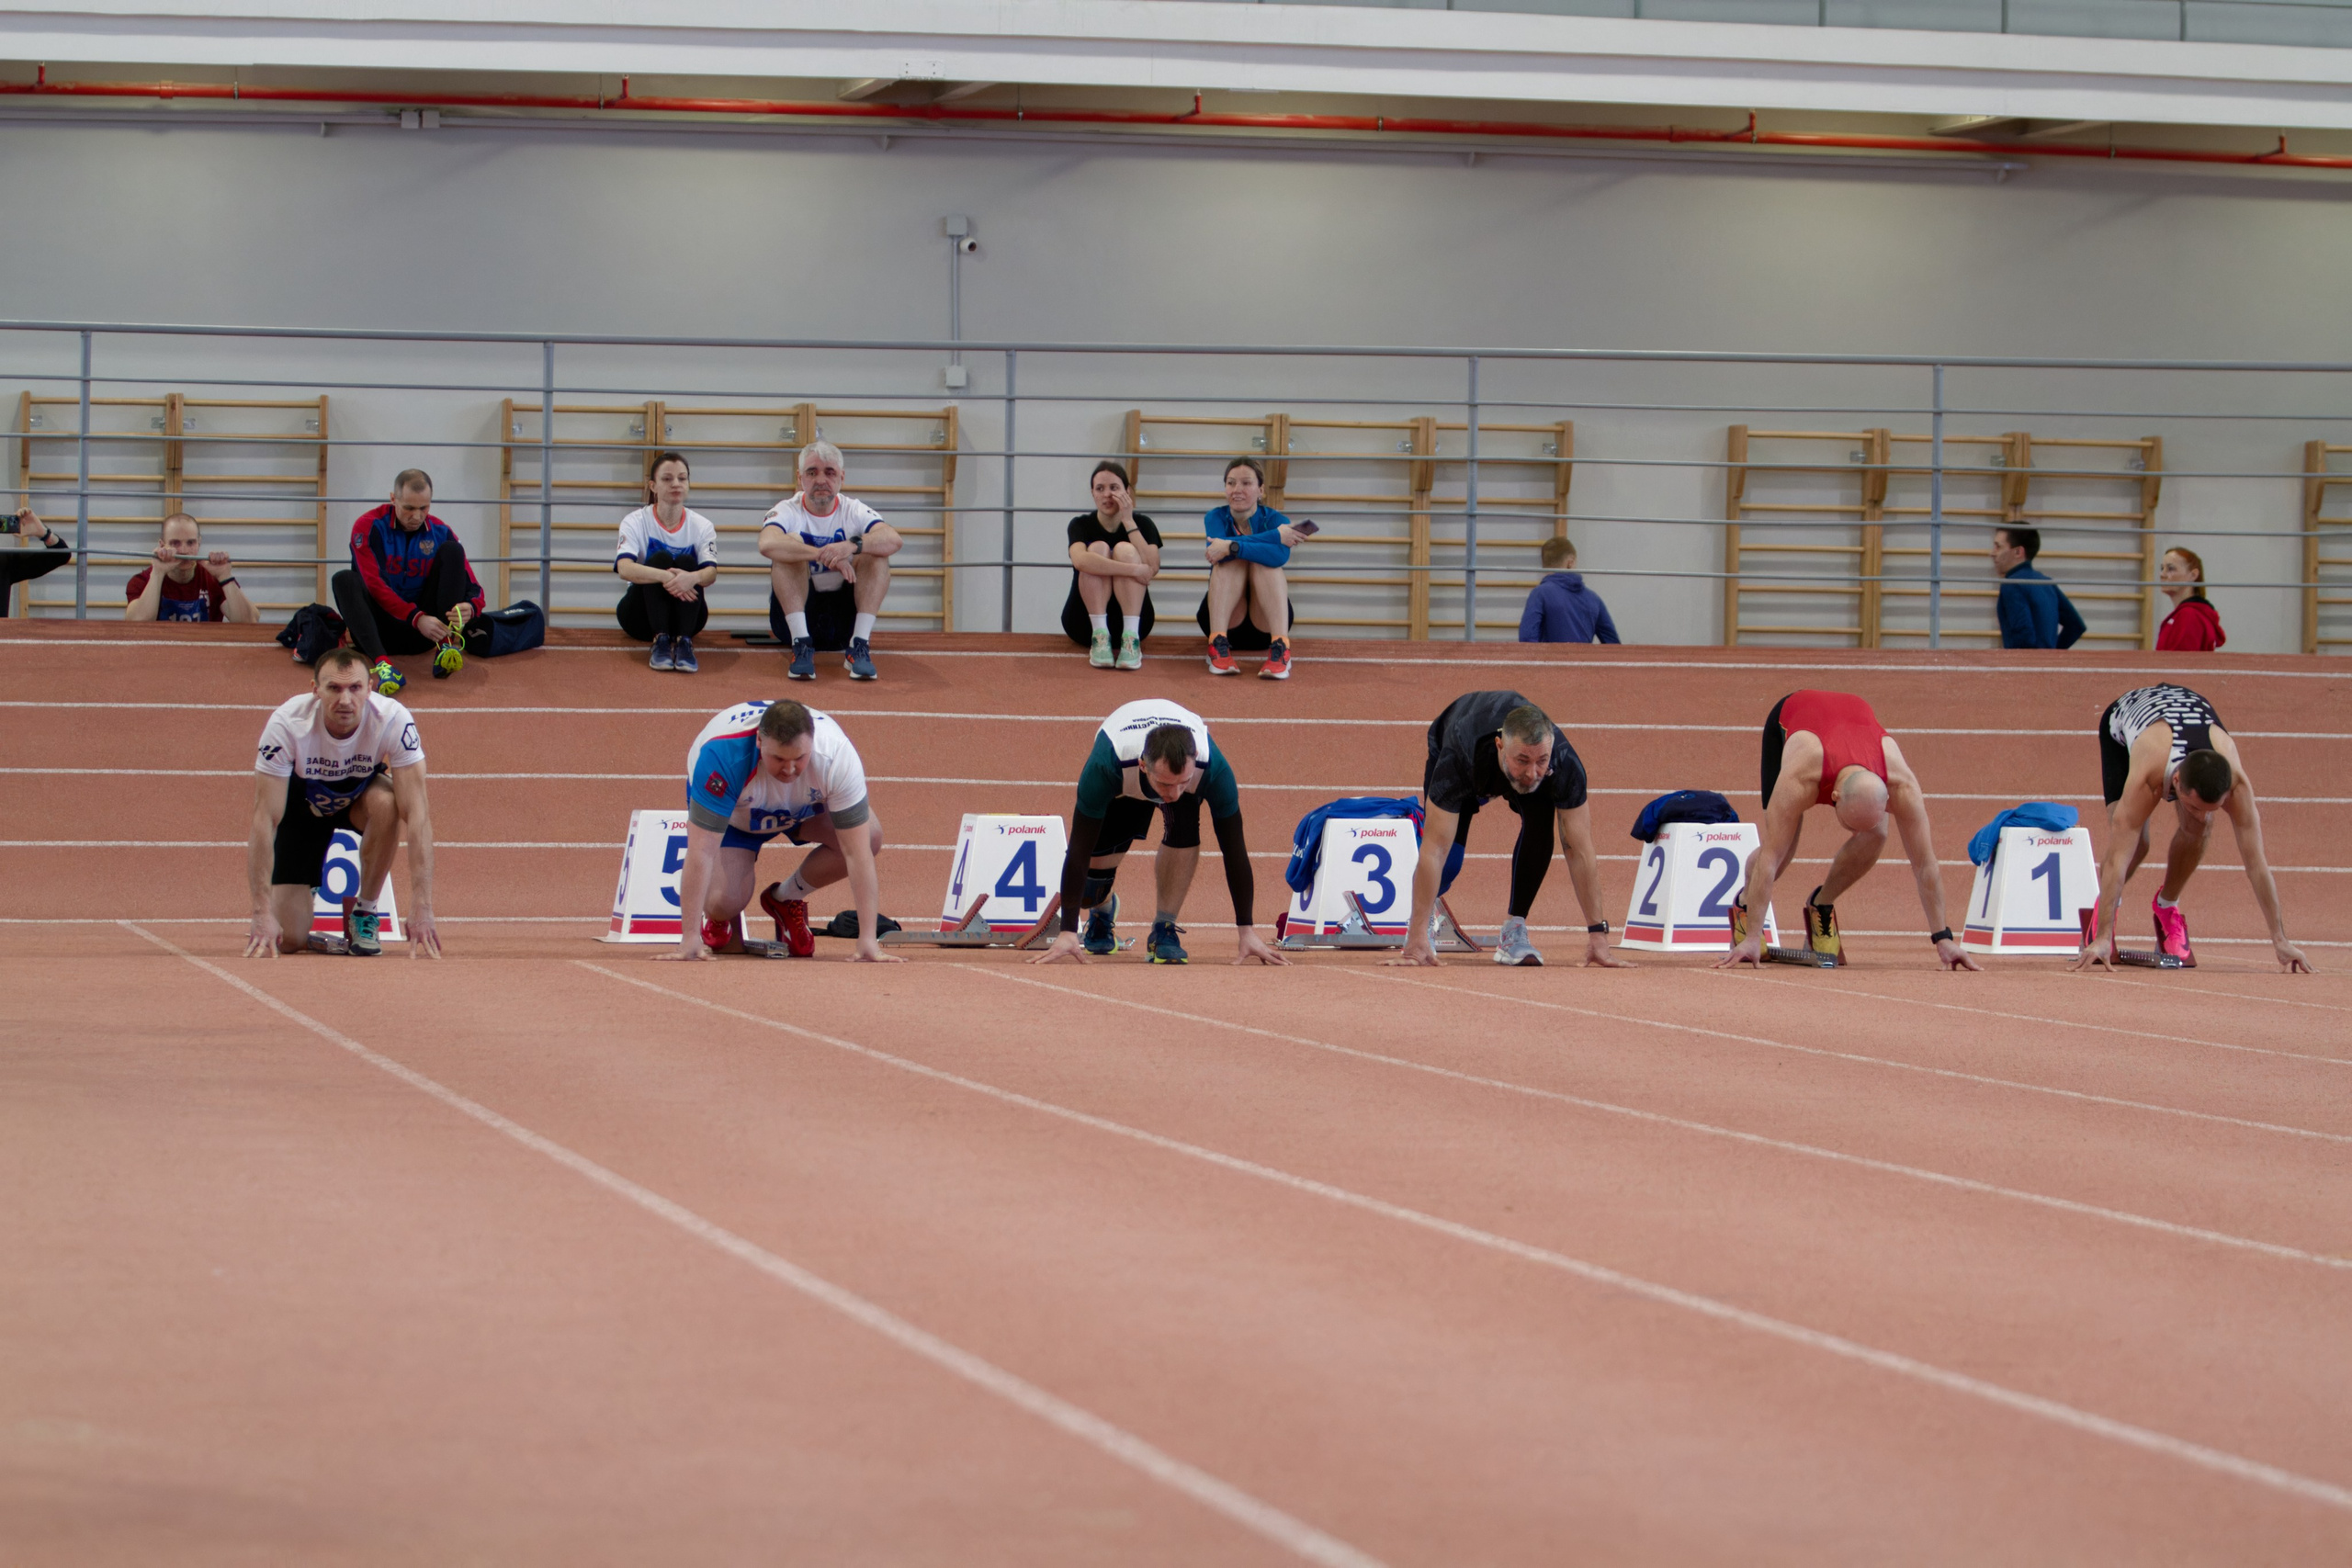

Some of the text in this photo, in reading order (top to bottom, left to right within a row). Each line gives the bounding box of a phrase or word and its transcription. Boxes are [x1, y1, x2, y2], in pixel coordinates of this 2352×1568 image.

[306, 754, 373, 768] ЗАВОД ИМЕНИ
[1008, 824, 1046, 836] polanik
[1360, 828, 1397, 839] polanik
[1705, 831, 1742, 842] polanik
[2037, 836, 2074, 847] polanik
[318, 832, 360, 905] 6
[618, 833, 635, 906] 5
[661, 835, 689, 908] 5
[952, 838, 970, 910] 4
[994, 840, 1046, 912] 4
[1351, 843, 1396, 915] 3
[1638, 845, 1666, 917] 2
[1697, 847, 1740, 918] 2
[2031, 852, 2063, 920] 1
